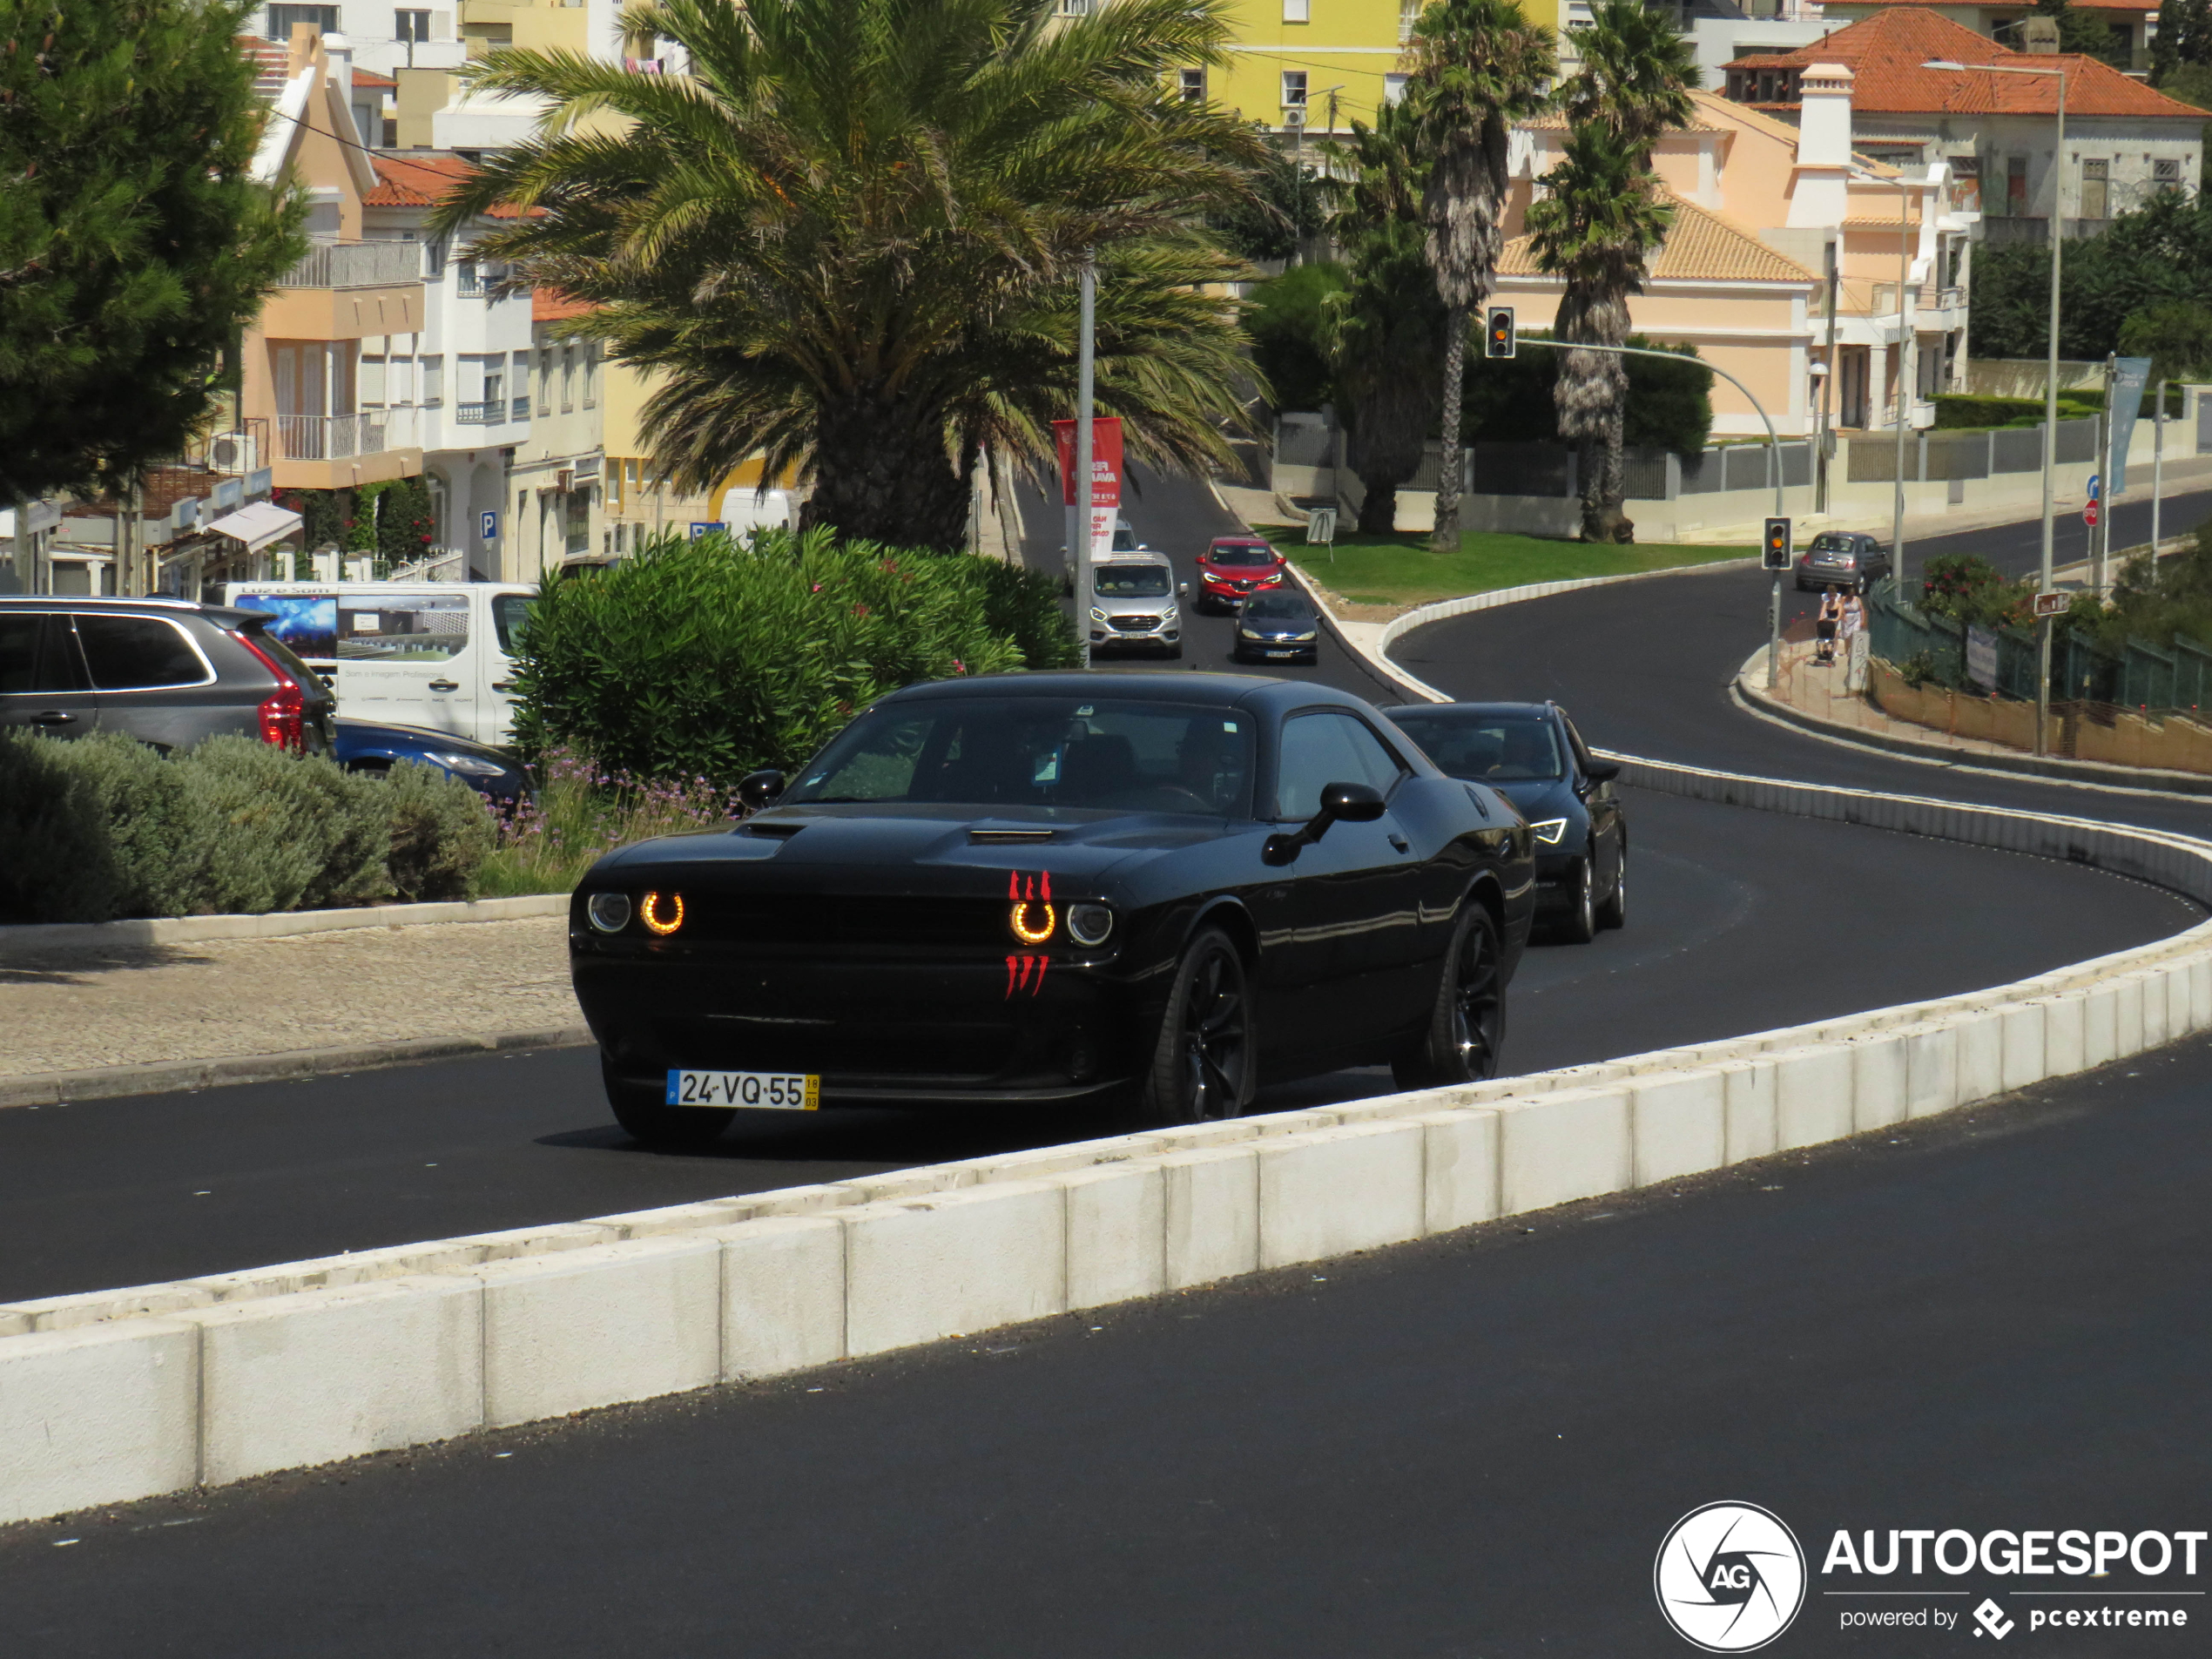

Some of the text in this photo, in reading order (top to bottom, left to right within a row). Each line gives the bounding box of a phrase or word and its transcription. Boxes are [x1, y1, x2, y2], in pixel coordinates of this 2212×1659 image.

[2083, 507, 2097, 517] STO
[483, 515, 494, 536] P
[691, 524, 706, 543] P
[806, 1078, 818, 1089] 18
[806, 1096, 817, 1107] 03
